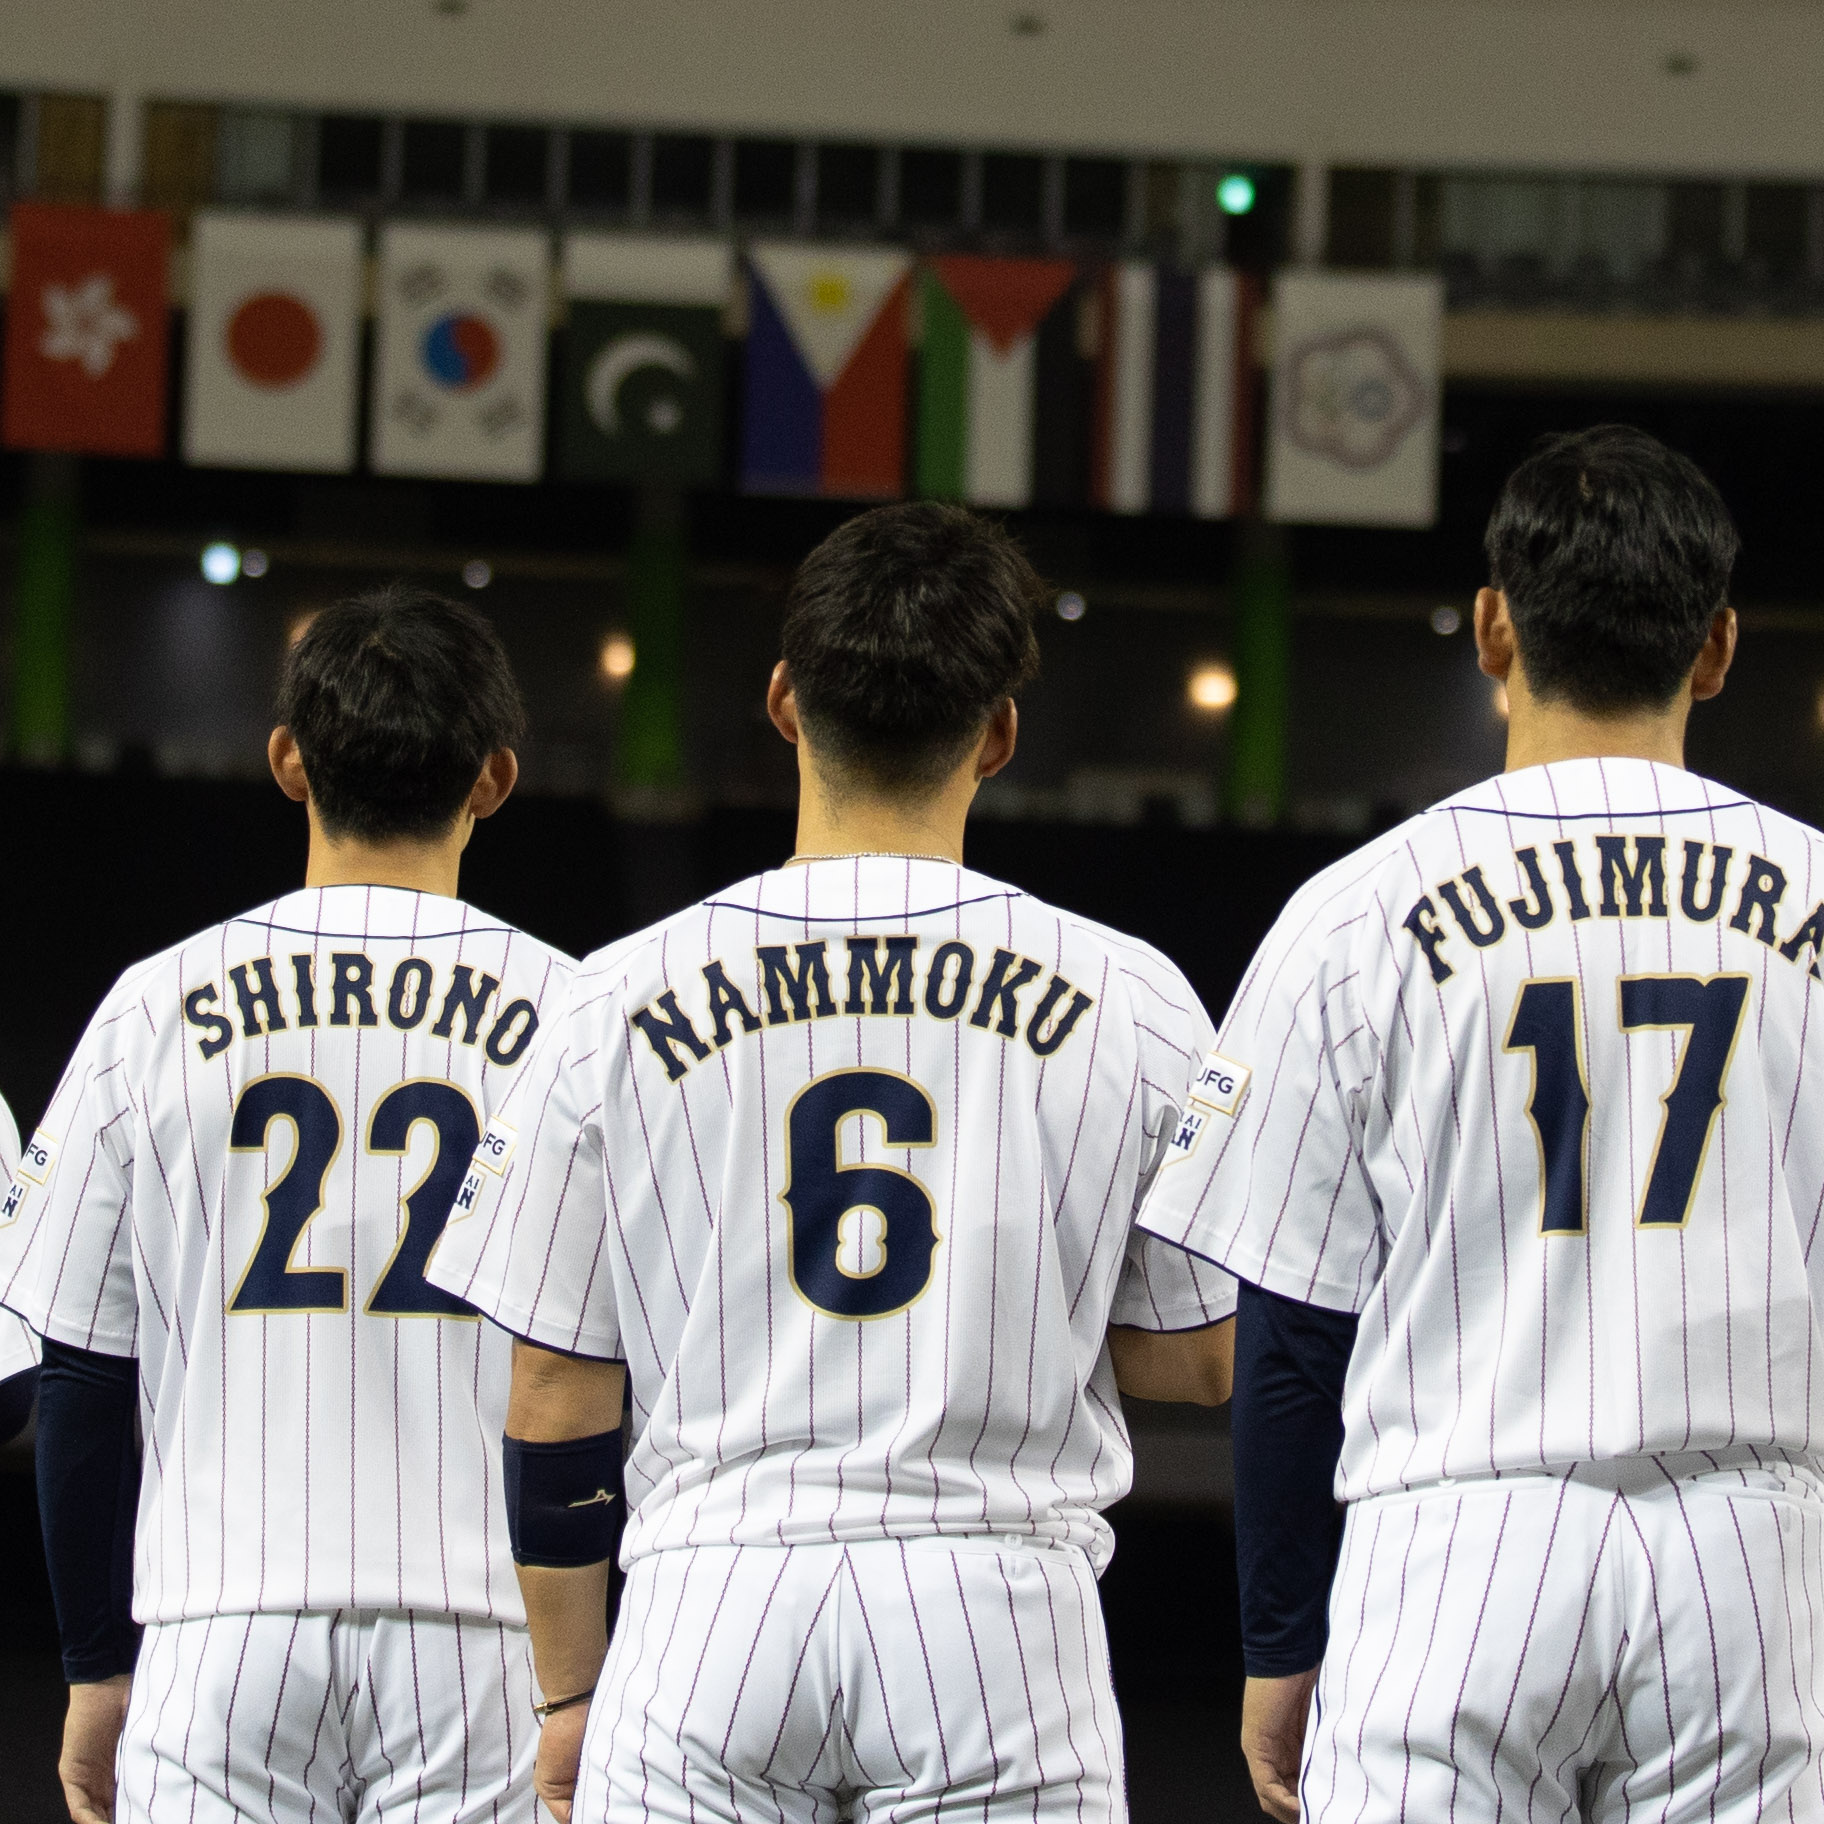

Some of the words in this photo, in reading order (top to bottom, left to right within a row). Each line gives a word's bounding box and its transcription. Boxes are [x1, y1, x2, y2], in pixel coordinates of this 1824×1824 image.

[181, 951, 540, 1068] SHIRONO
[630, 934, 1095, 1085] NAMMOKU
[1502, 972, 1753, 1239] 17
[24, 1142, 49, 1167] FG
[225, 1071, 483, 1322] 22
[776, 1065, 944, 1322] 6
